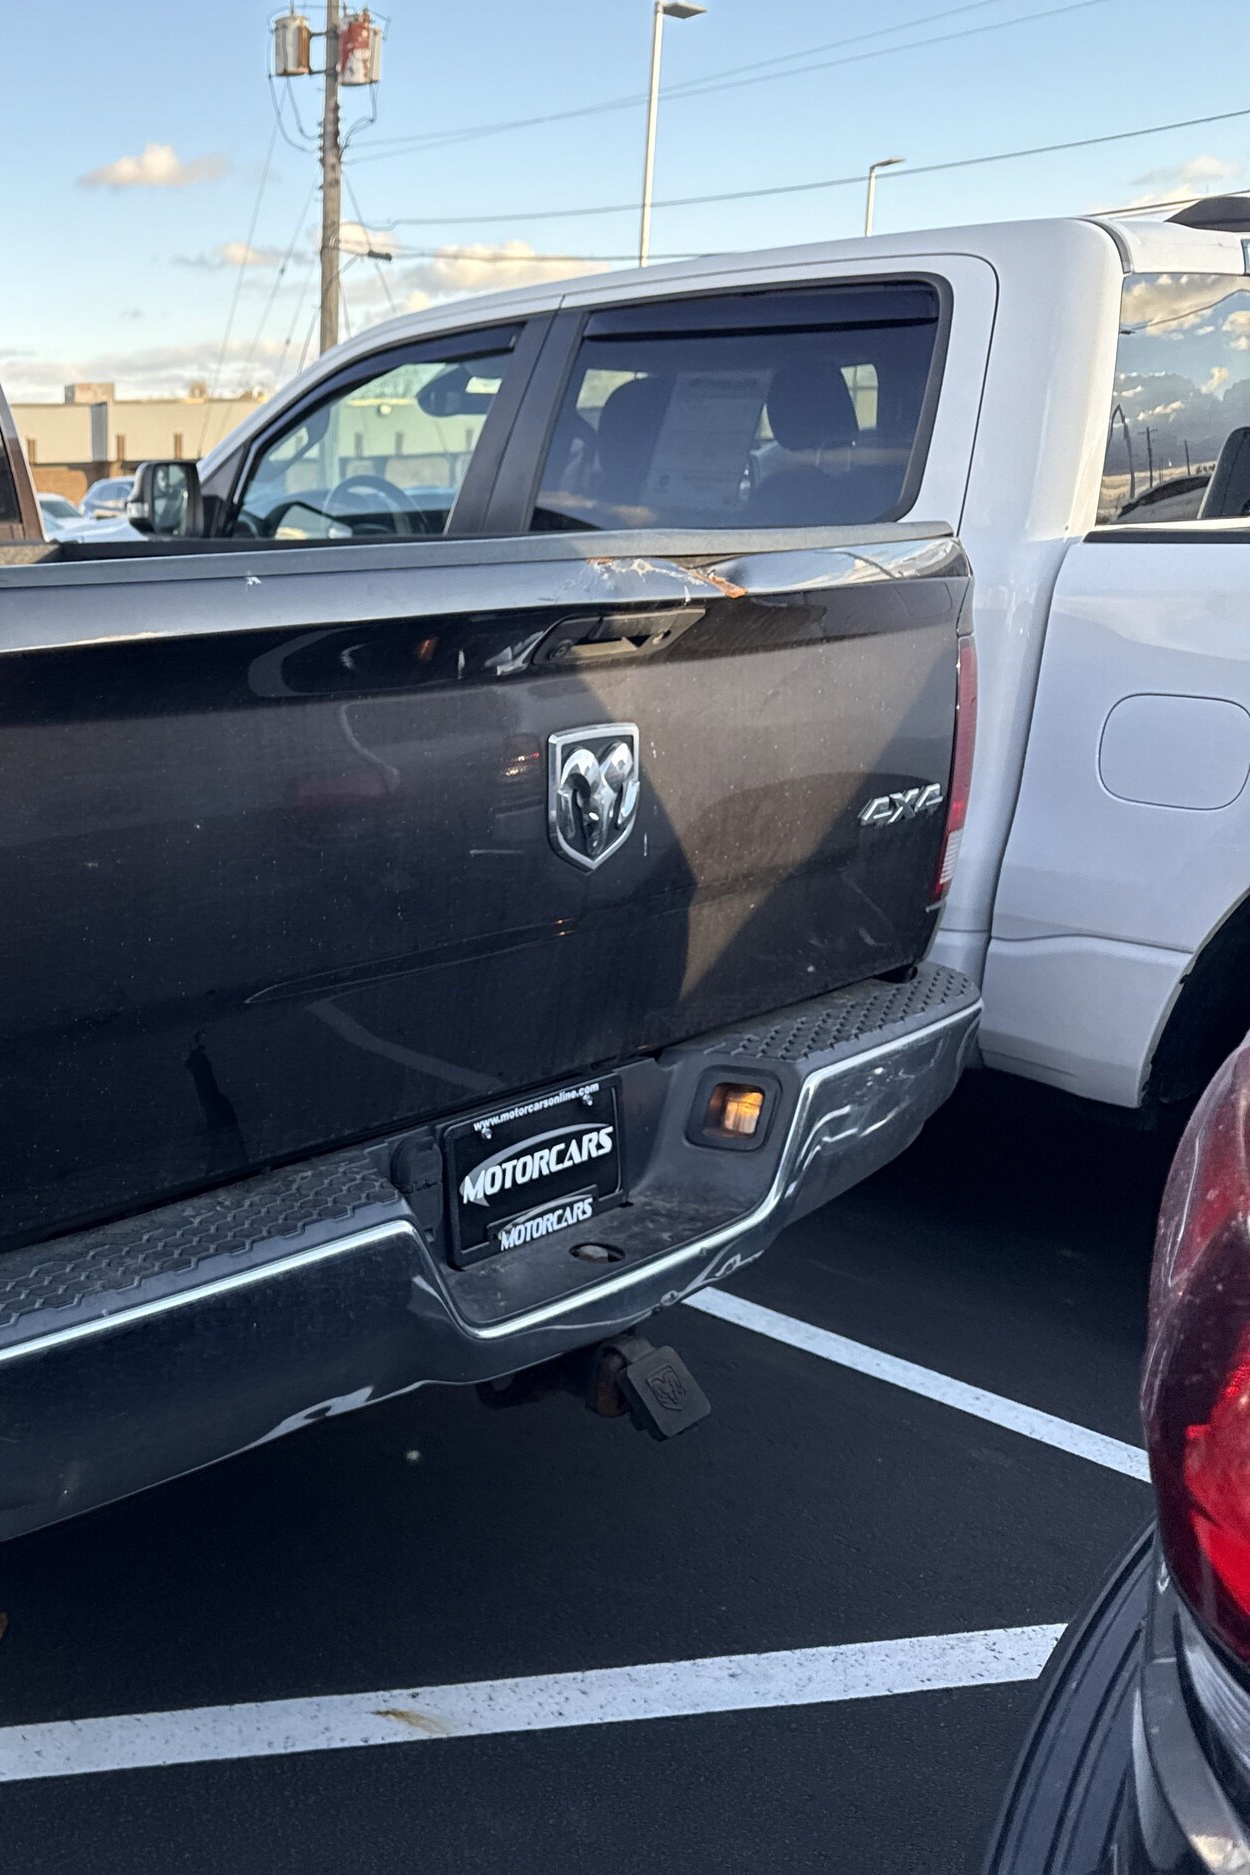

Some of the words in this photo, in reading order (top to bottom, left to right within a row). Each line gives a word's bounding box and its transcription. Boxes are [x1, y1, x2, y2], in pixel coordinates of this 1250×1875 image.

[473, 1082, 600, 1132] www.motorcarsonline.com
[462, 1125, 614, 1205] MOTORCARS
[500, 1197, 593, 1252] MOTORCARS
